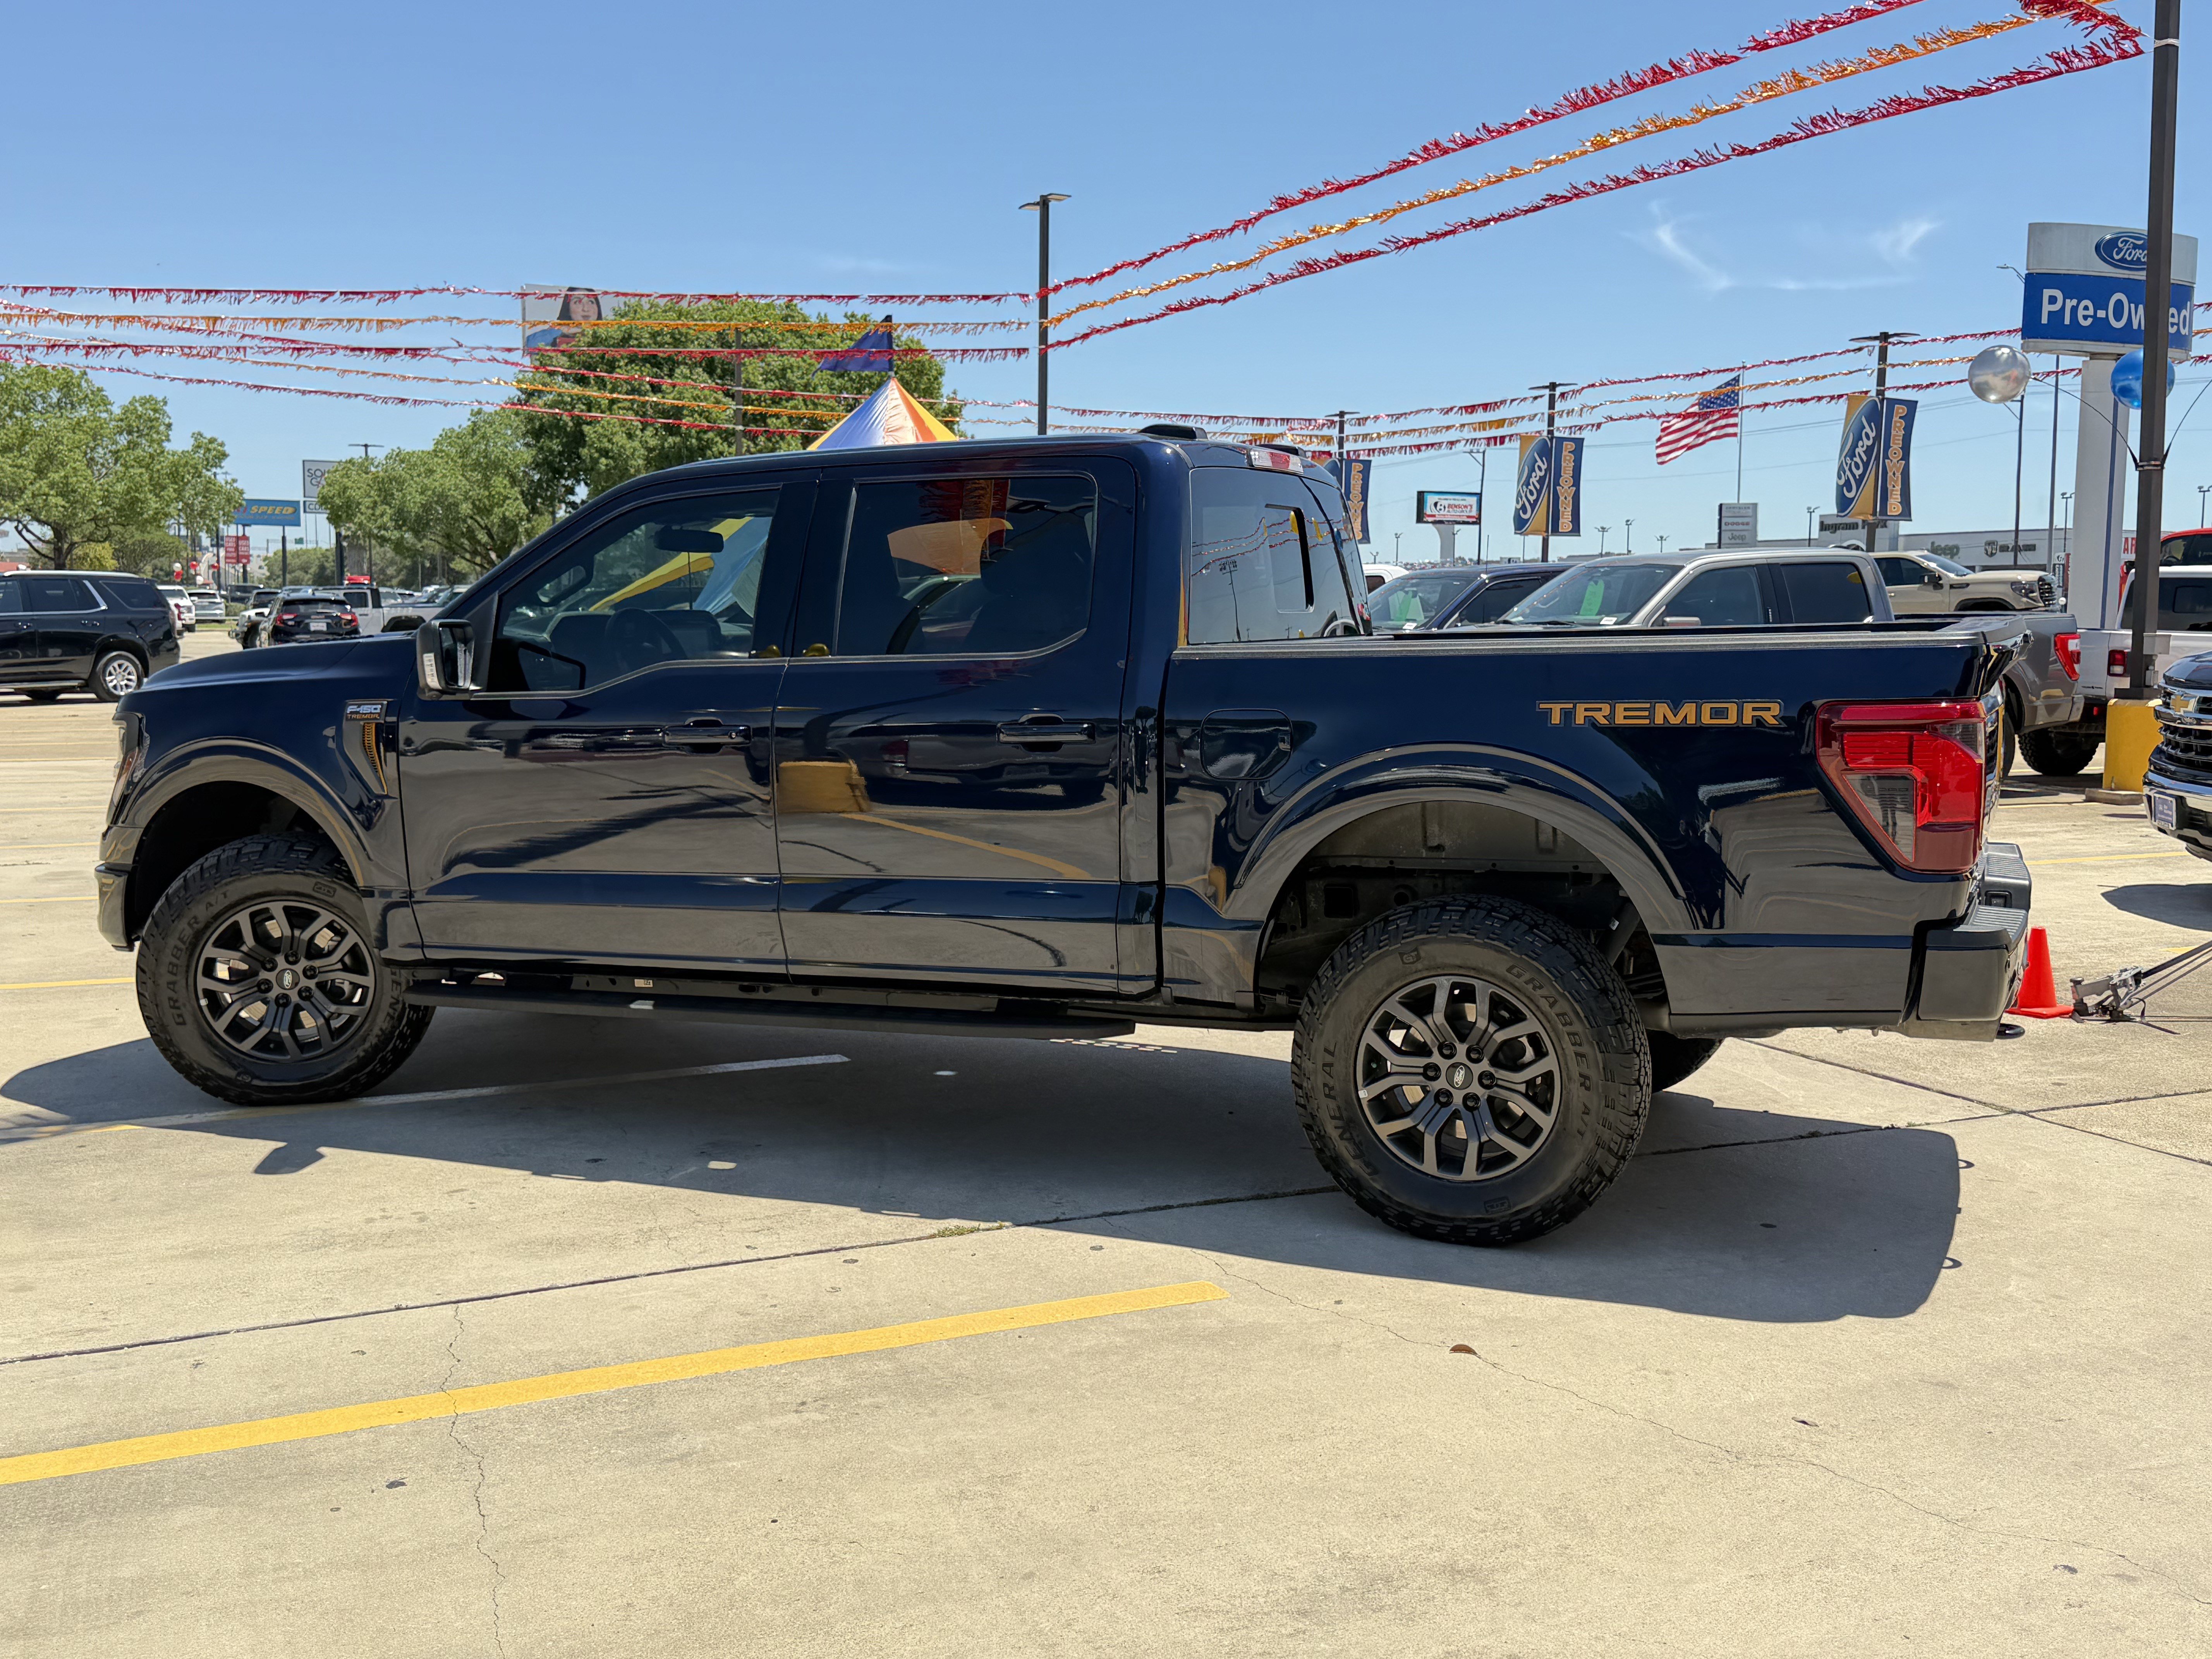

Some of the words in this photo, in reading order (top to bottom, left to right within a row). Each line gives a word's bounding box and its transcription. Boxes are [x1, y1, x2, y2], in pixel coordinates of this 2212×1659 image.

[2041, 289, 2190, 335] Pre-Owed
[1516, 452, 1547, 519] Ford
[1556, 441, 1576, 532] PREOWNED
[1837, 415, 1876, 498] Ford
[1885, 404, 1907, 515] PREOWNED
[250, 505, 297, 515] SPEED
[1820, 520, 1859, 534] Ingram
[1536, 700, 1786, 727] TREMOR
[167, 915, 199, 1026] GRABBER
[1506, 964, 1592, 1093] GRABBER
[1322, 1042, 1379, 1177] GENERAL
